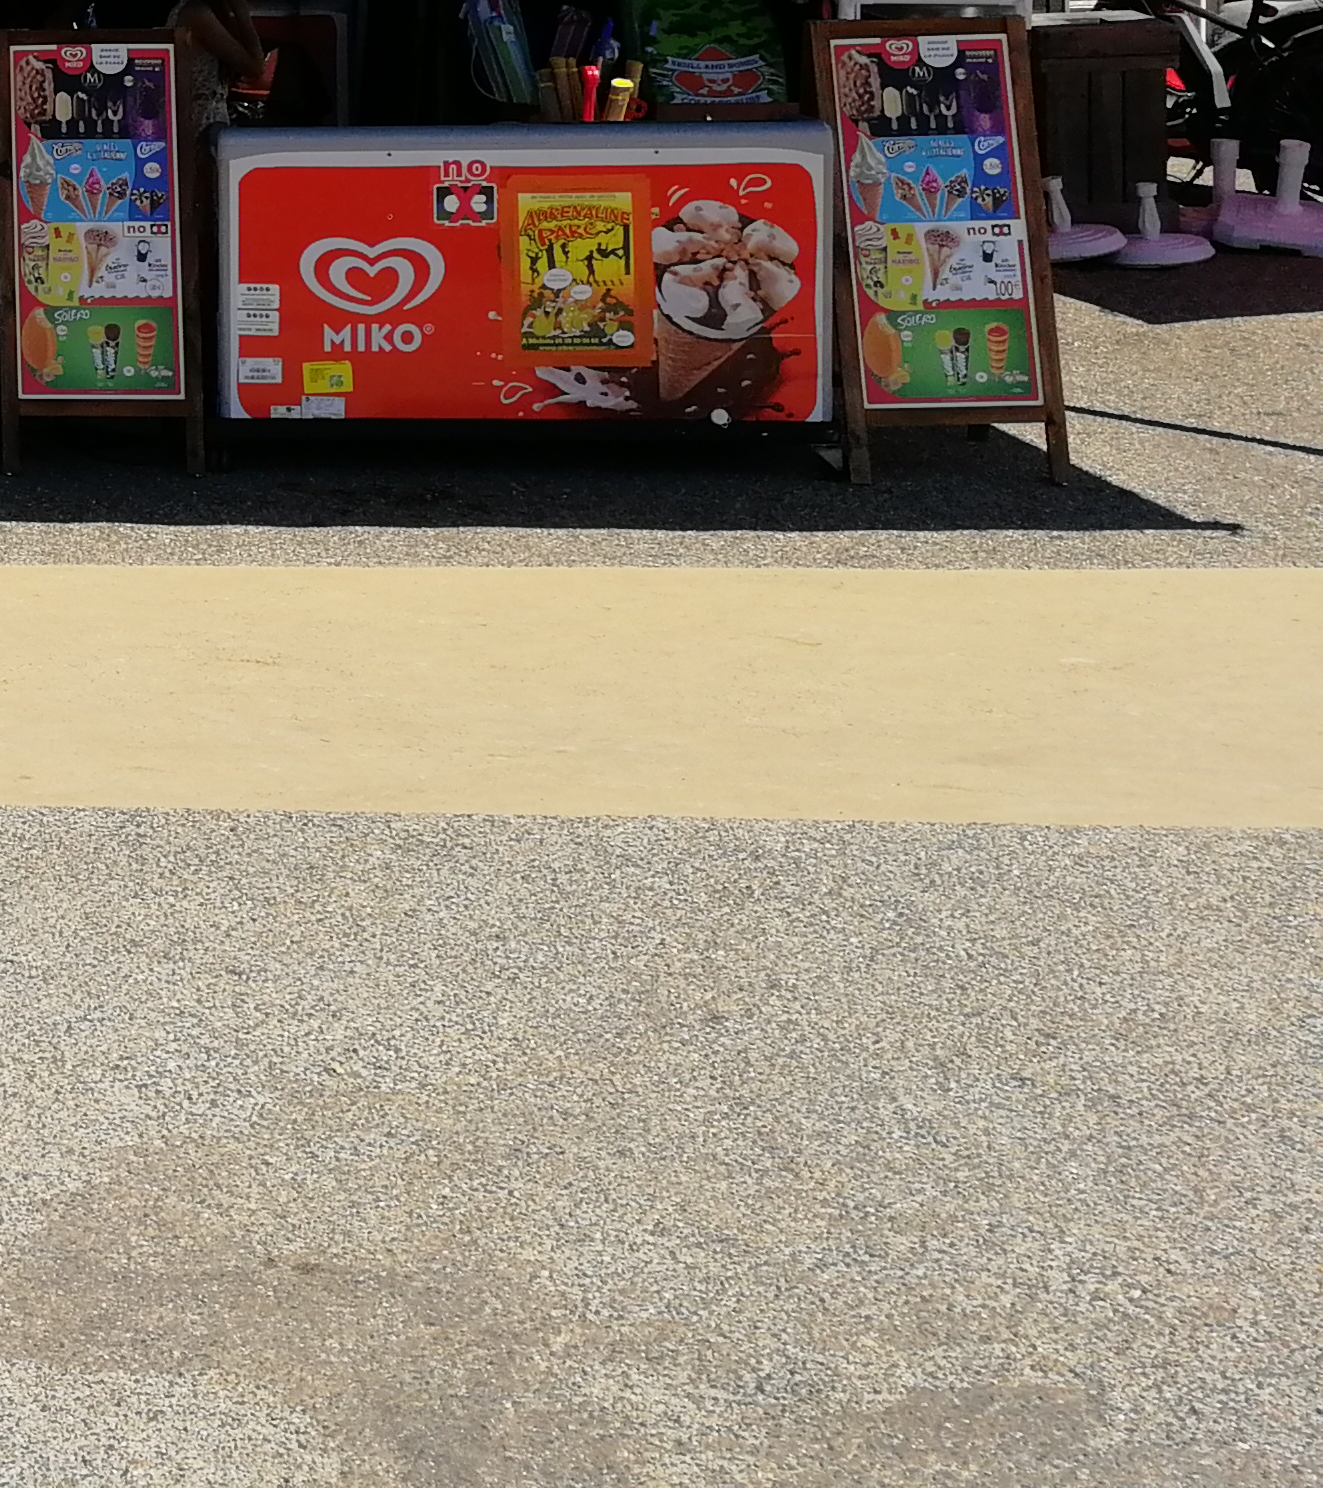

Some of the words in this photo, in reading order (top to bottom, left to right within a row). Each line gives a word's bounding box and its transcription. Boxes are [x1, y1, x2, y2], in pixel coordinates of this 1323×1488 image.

[671, 60, 702, 70] SKULL
[704, 62, 726, 70] AND
[442, 159, 489, 180] no
[521, 204, 632, 233] ADRENALINE
[127, 225, 146, 234] no
[535, 222, 596, 247] PARC
[966, 226, 987, 236] no
[323, 323, 422, 353] MIKO
